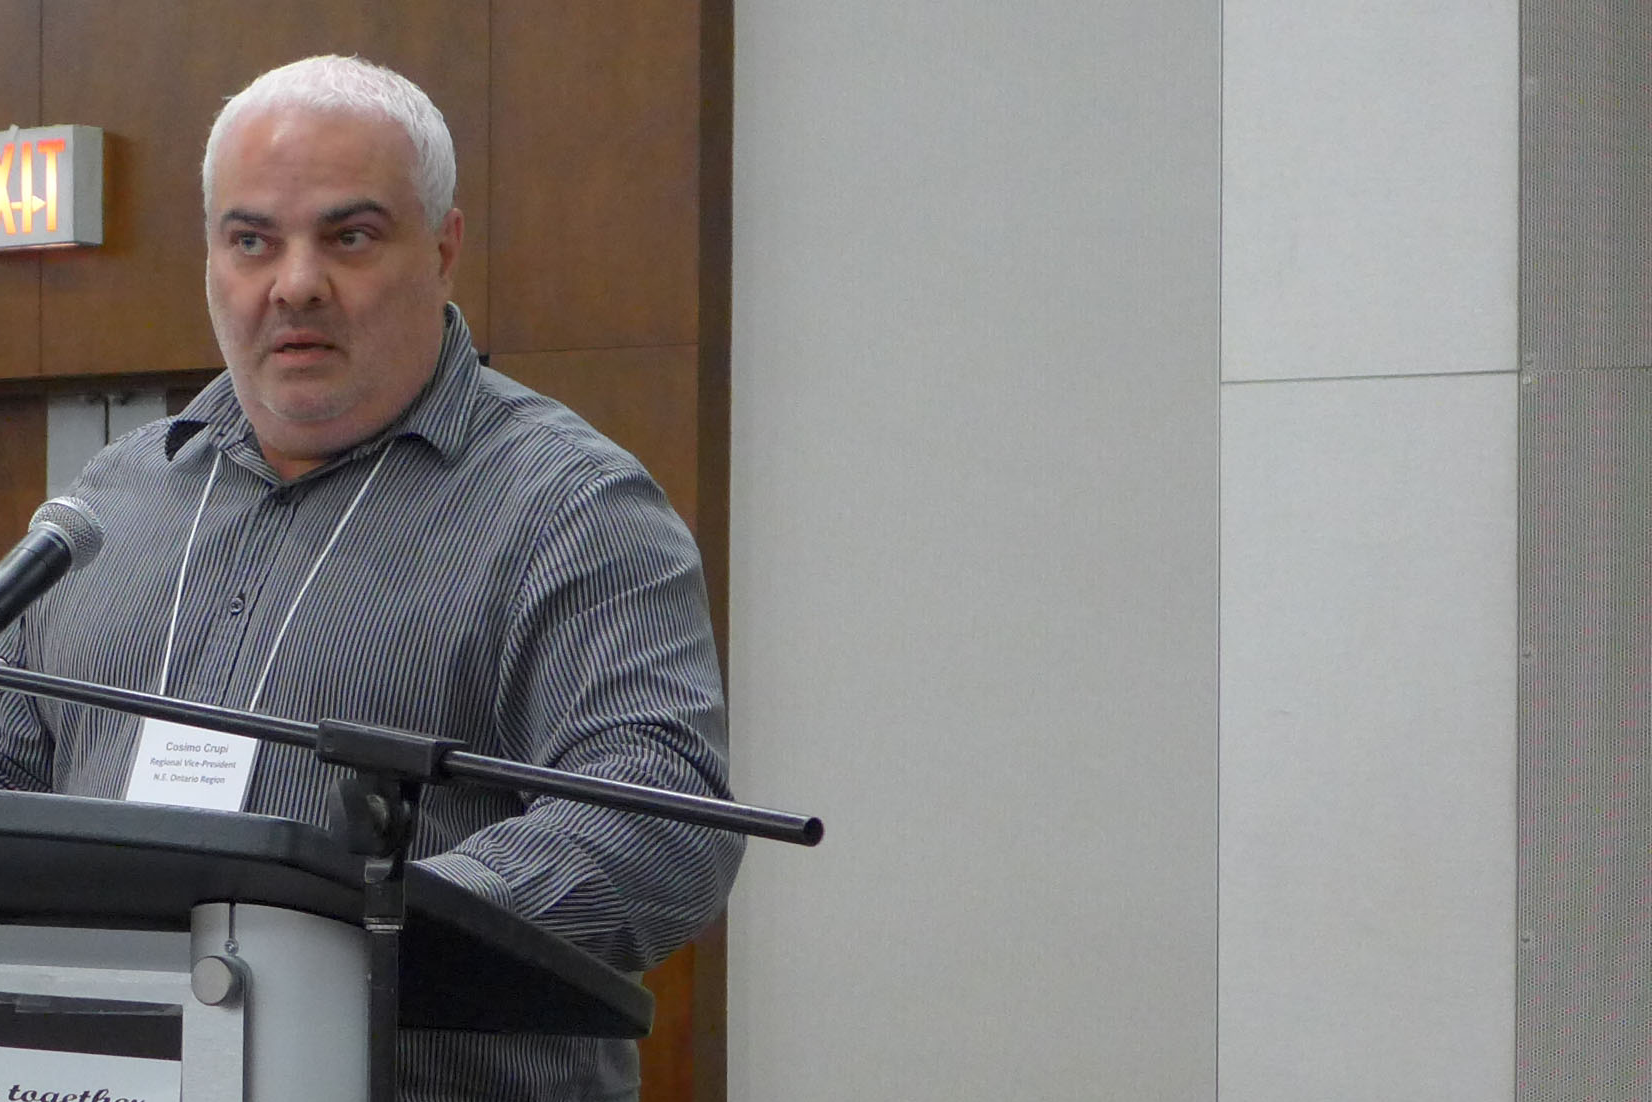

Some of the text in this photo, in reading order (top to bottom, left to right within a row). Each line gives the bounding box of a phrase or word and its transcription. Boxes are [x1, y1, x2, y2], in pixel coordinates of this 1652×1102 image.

[166, 741, 201, 753] Cosimo
[150, 757, 182, 768] Regional
[170, 774, 198, 783] Ontario
[200, 776, 225, 785] Region
